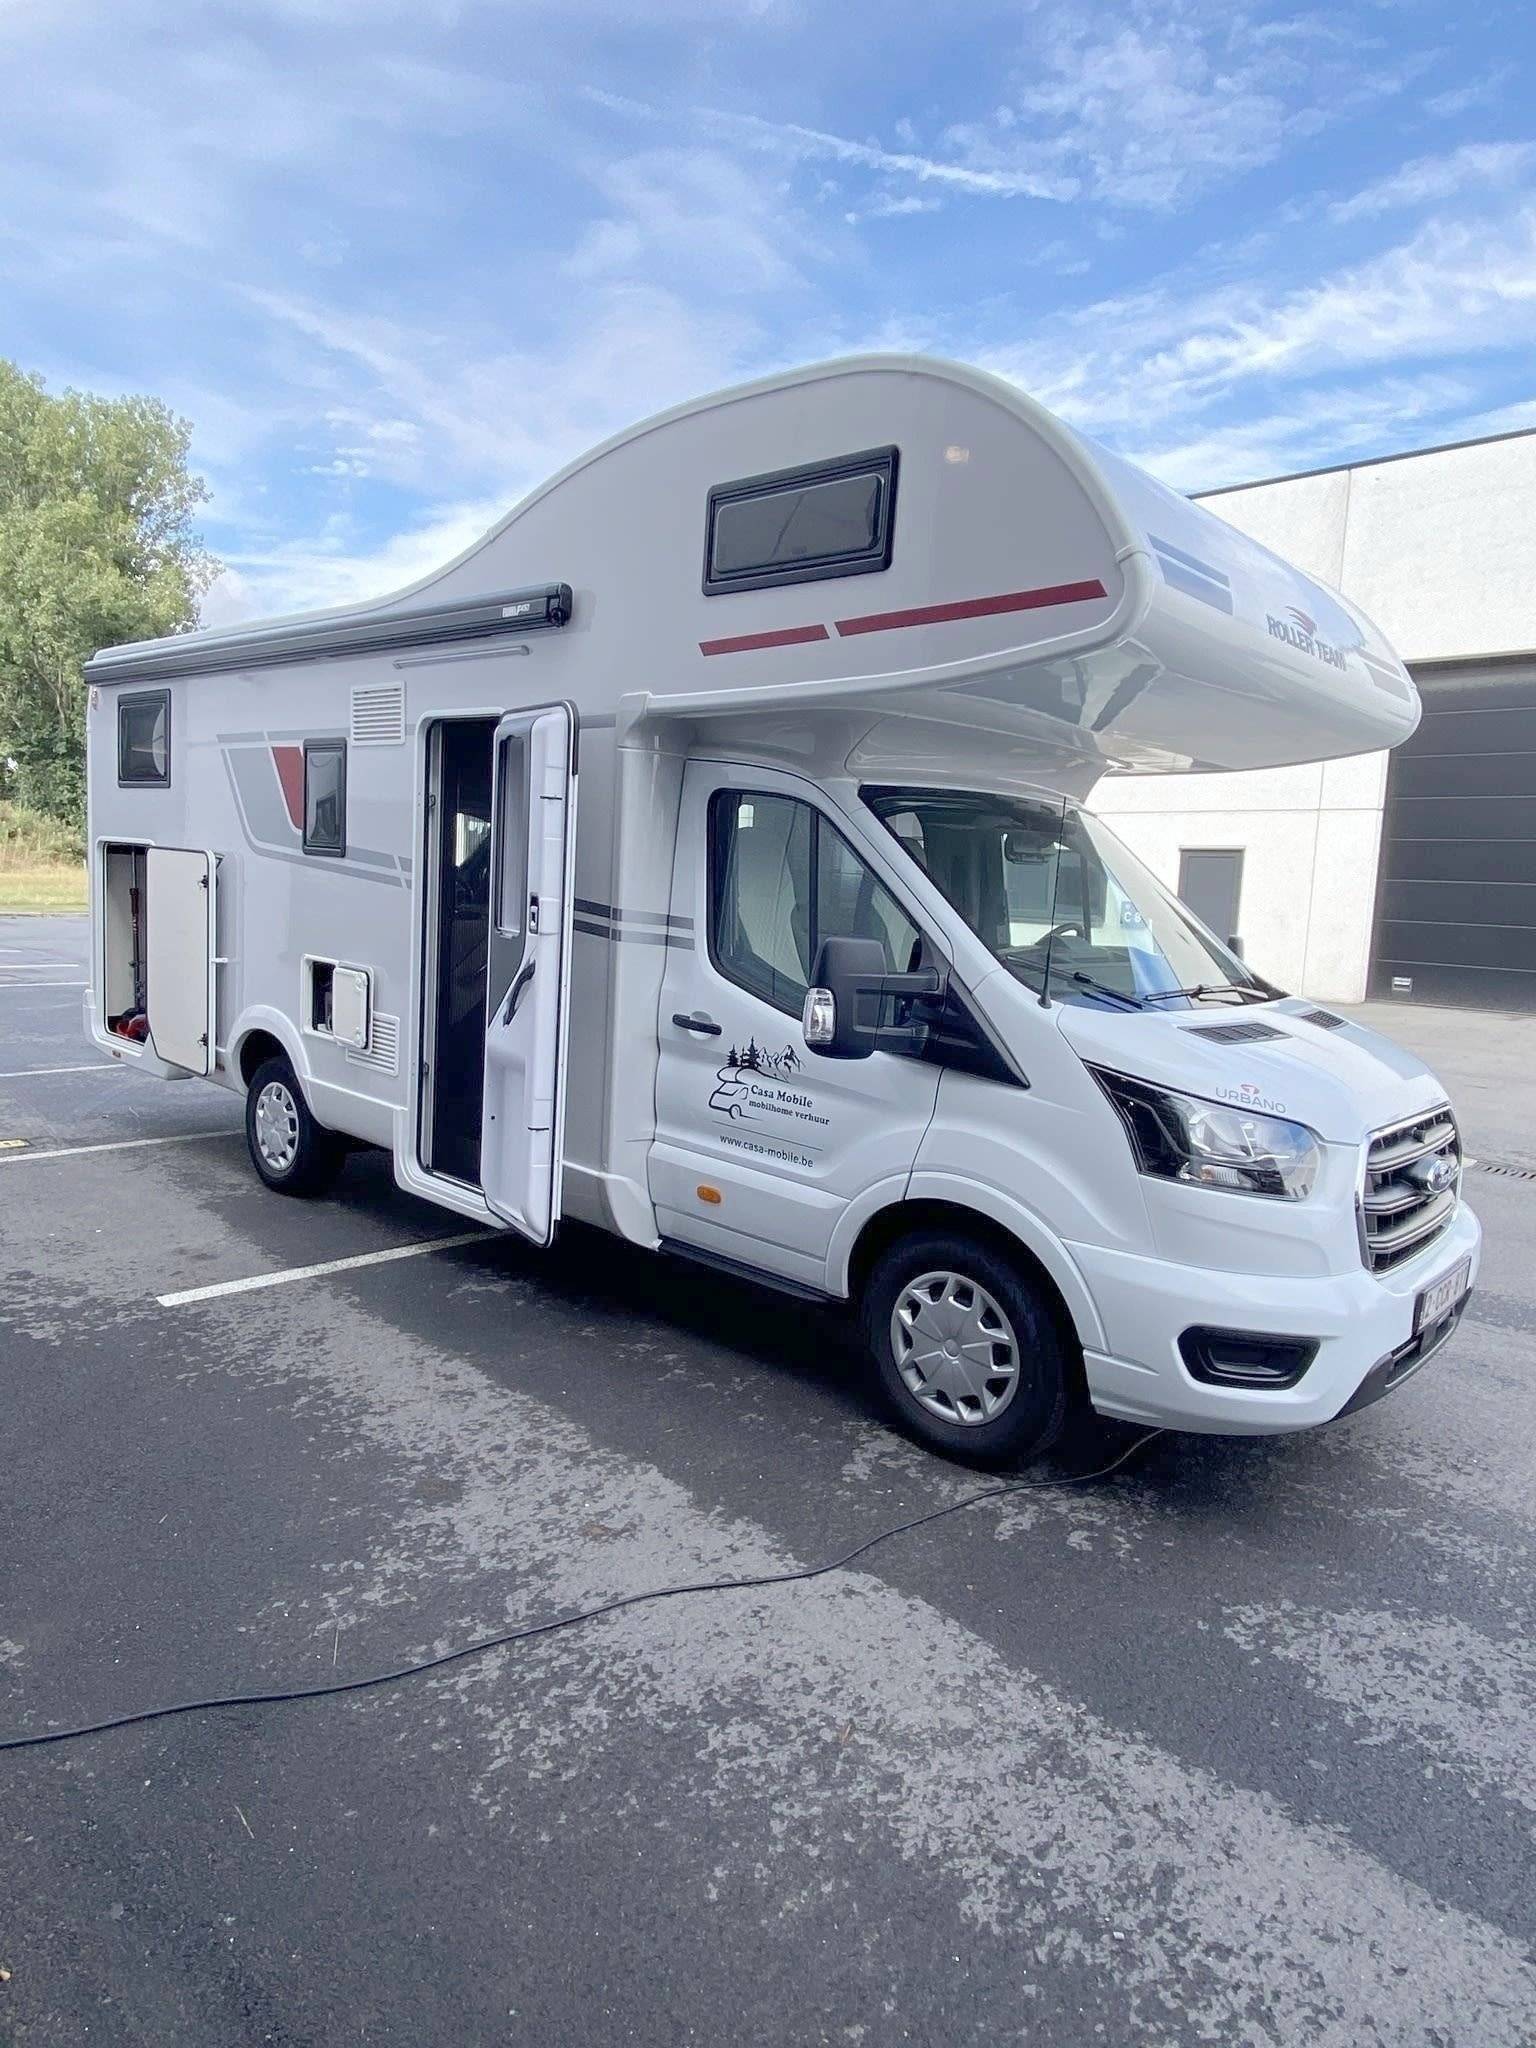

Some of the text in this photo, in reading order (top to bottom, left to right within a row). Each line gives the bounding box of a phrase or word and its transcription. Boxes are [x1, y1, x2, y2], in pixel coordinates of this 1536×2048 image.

[1266, 613, 1347, 671] ROLLER TEAM
[751, 1084, 813, 1108] Casa Mobile
[1215, 1086, 1287, 1114] URBANO
[748, 1099, 830, 1126] mobilhome verhuur
[720, 1134, 814, 1168] www.casa-mobile.be
